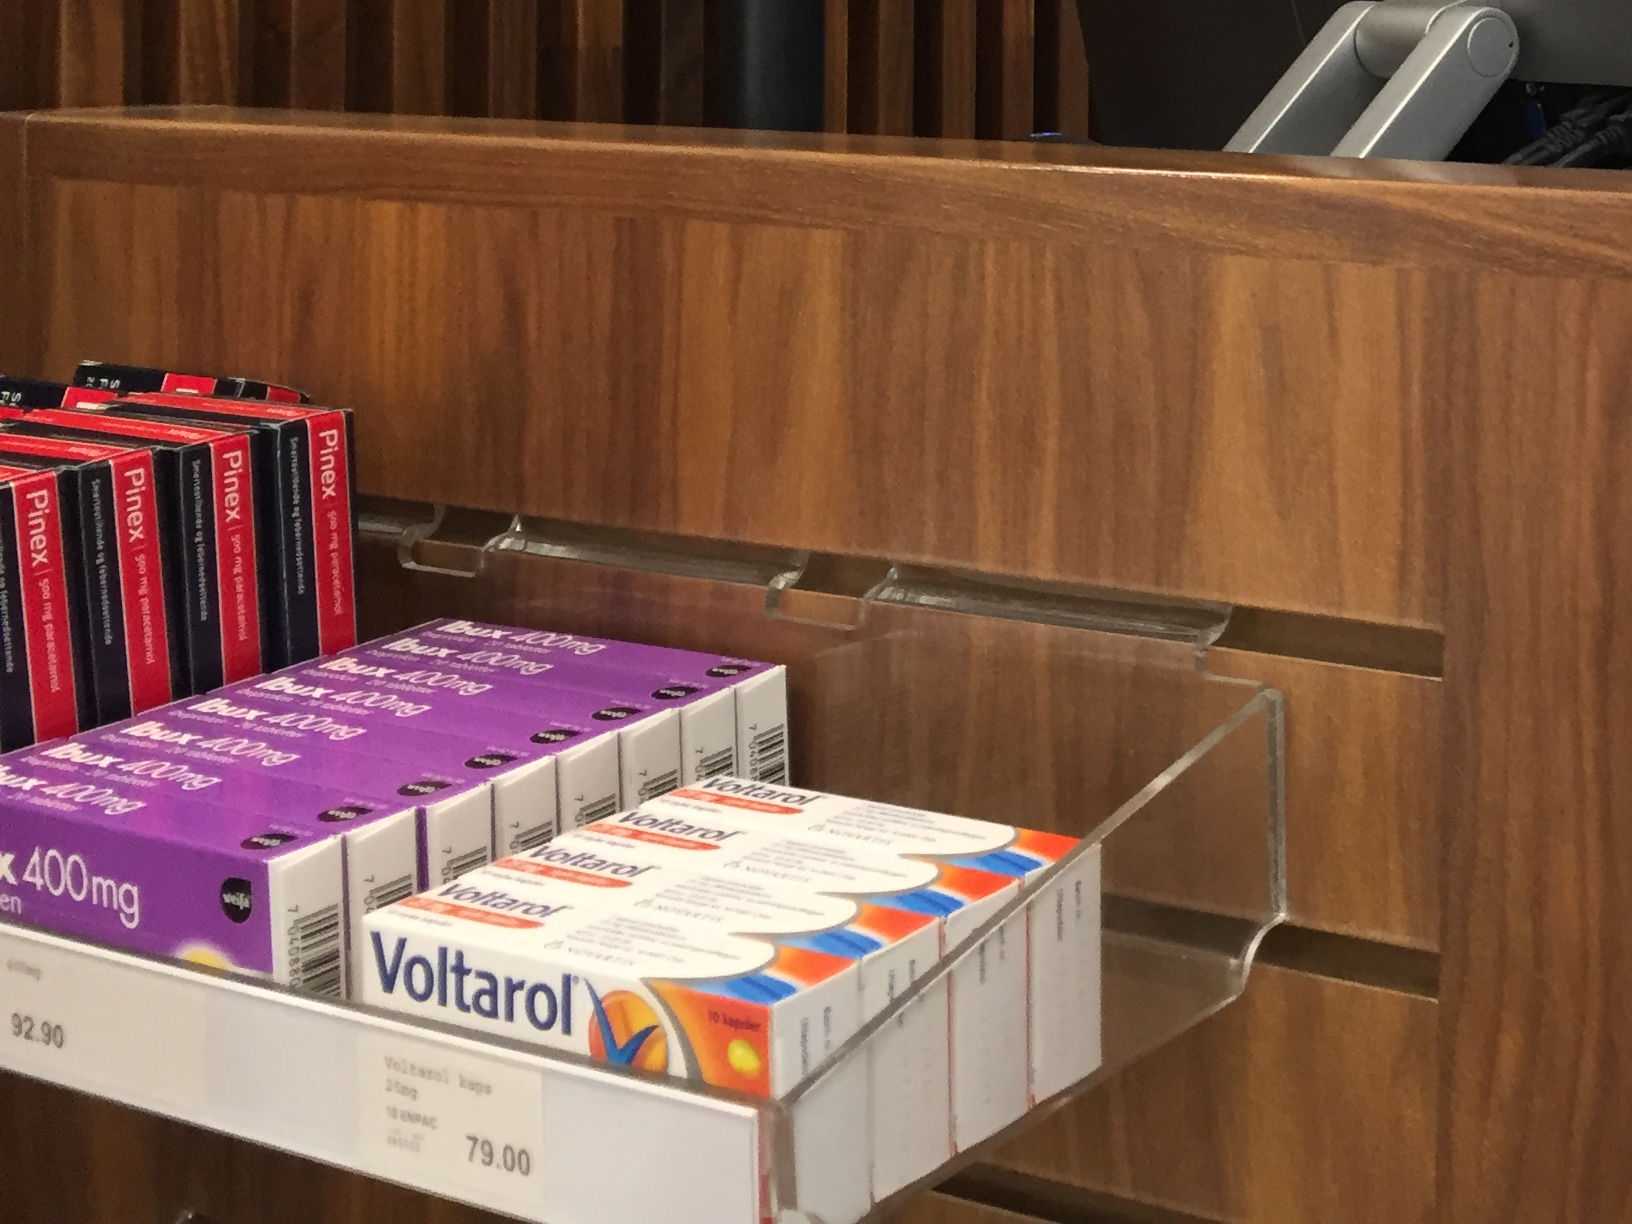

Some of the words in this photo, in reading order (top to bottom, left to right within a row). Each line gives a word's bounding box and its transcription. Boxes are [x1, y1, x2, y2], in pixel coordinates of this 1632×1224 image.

[319, 430, 339, 501] Pinex
[222, 450, 242, 524] Pinex
[124, 468, 145, 543] Pinex
[26, 489, 50, 567] Pinex
[436, 620, 513, 639] Ibux
[382, 637, 459, 658] Ibux
[318, 657, 396, 678] Ibux
[254, 676, 336, 698] Ibux
[186, 697, 270, 720] Ibux
[120, 721, 204, 745] Ibux
[40, 742, 125, 768] Ibux
[701, 776, 820, 807] Voltarol
[617, 811, 740, 841] Voltarol
[527, 844, 654, 878] Voltarol
[437, 883, 567, 918] Voltarol
[370, 930, 573, 1037] Voltarol
[11, 1012, 64, 1049] 92.90
[466, 1134, 531, 1176] 79.00
